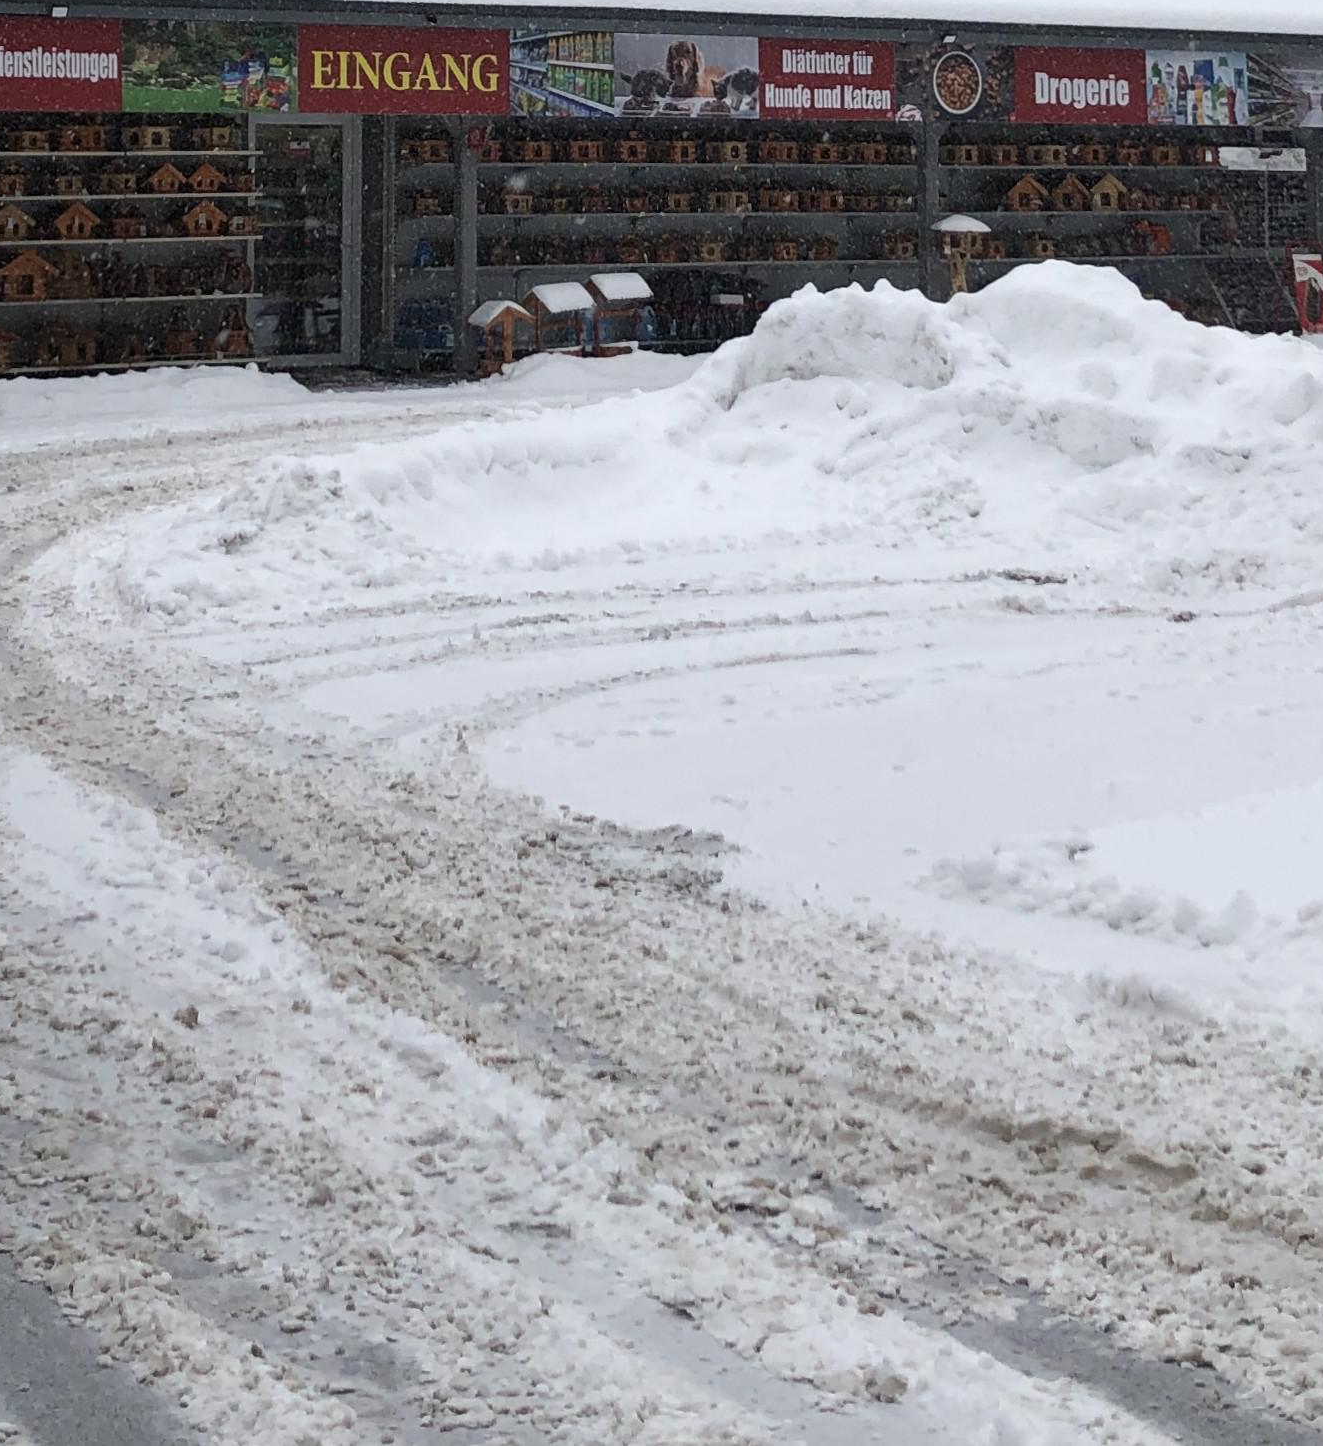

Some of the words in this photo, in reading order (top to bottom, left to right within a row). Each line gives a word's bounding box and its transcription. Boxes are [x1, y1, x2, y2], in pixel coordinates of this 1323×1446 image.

[310, 50, 510, 92] EINGANG
[782, 48, 851, 75] Diätfutter
[853, 50, 874, 75] für
[764, 83, 811, 108] Hunde
[814, 85, 841, 109] und
[843, 84, 892, 110] Katzen
[1034, 71, 1130, 109] Drogerie
